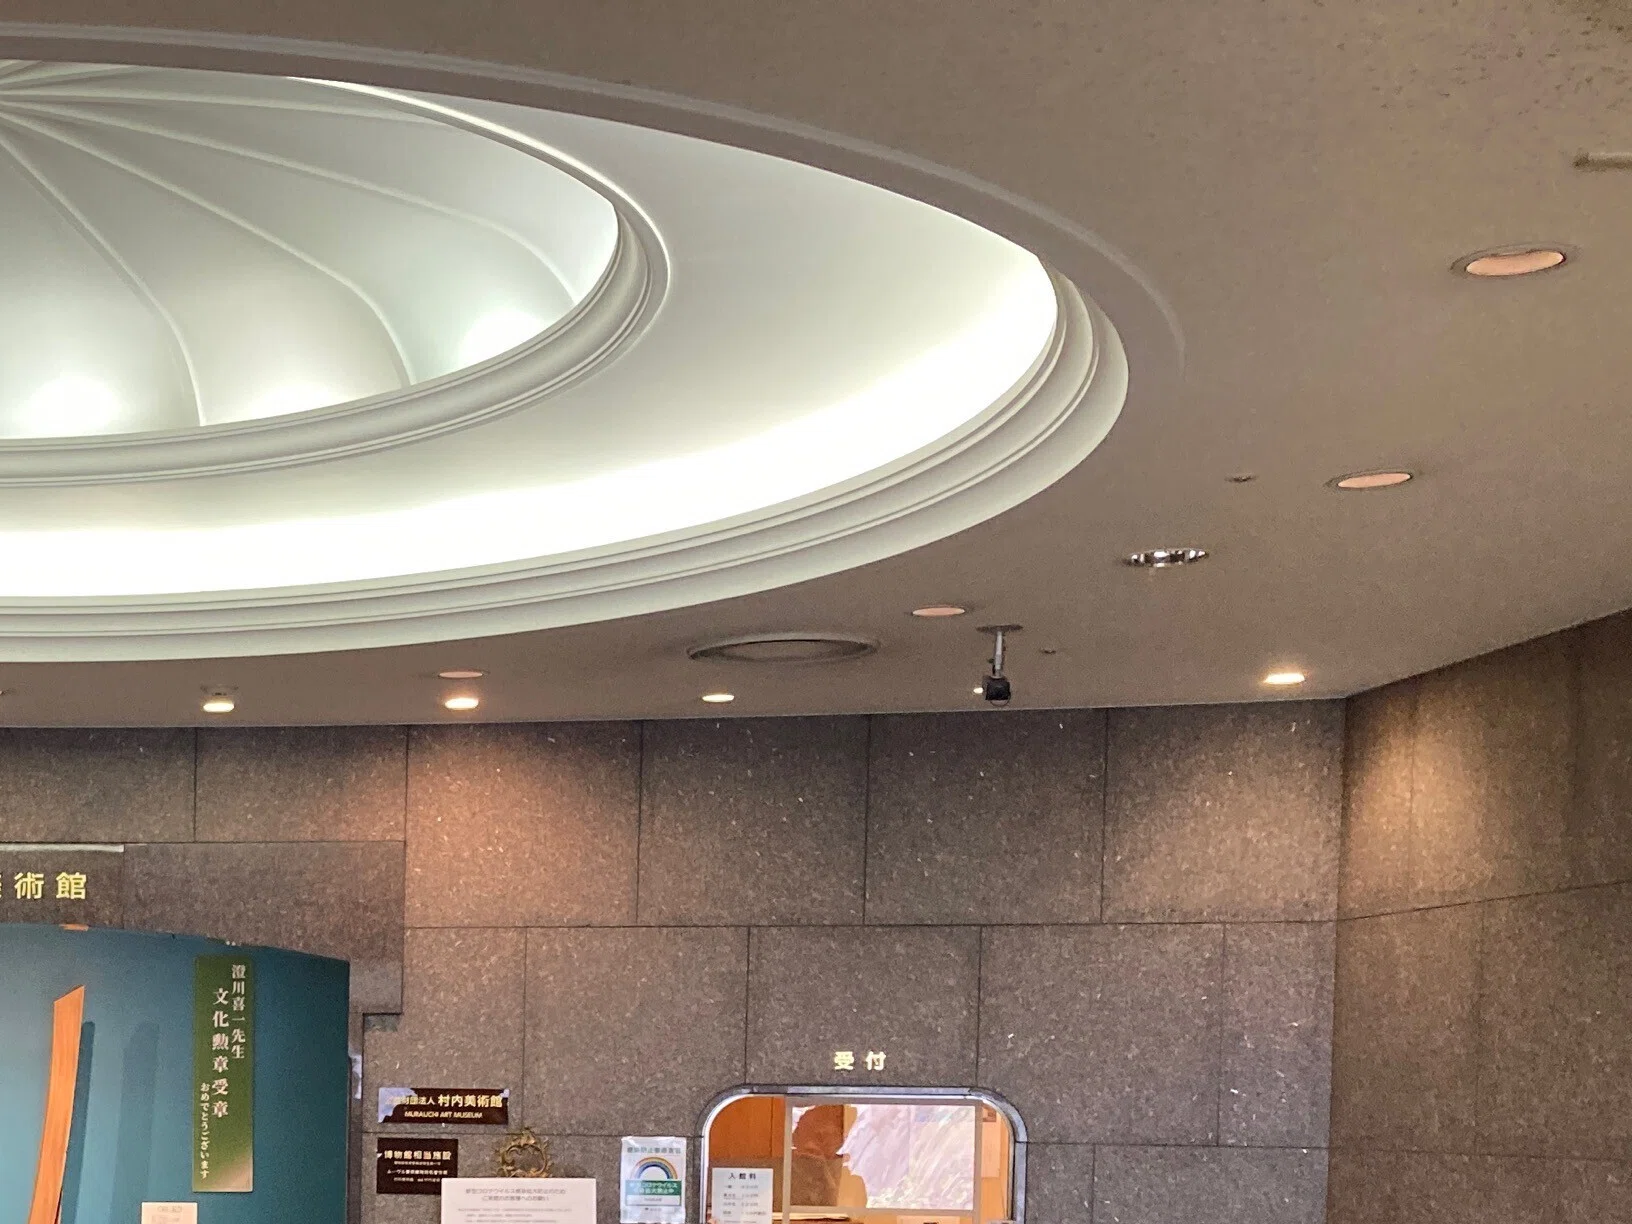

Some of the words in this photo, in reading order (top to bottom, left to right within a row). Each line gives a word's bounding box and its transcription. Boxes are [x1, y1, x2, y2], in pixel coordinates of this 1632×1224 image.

[231, 964, 247, 1059] 澄川喜一先生
[211, 987, 230, 1118] 文化勲章受章
[834, 1051, 887, 1071] 受付
[385, 1095, 436, 1106] 財団法人
[437, 1094, 503, 1108] 村内美術館
[453, 1111, 483, 1119] MUSEUM
[200, 1082, 211, 1179] おめでとうございます
